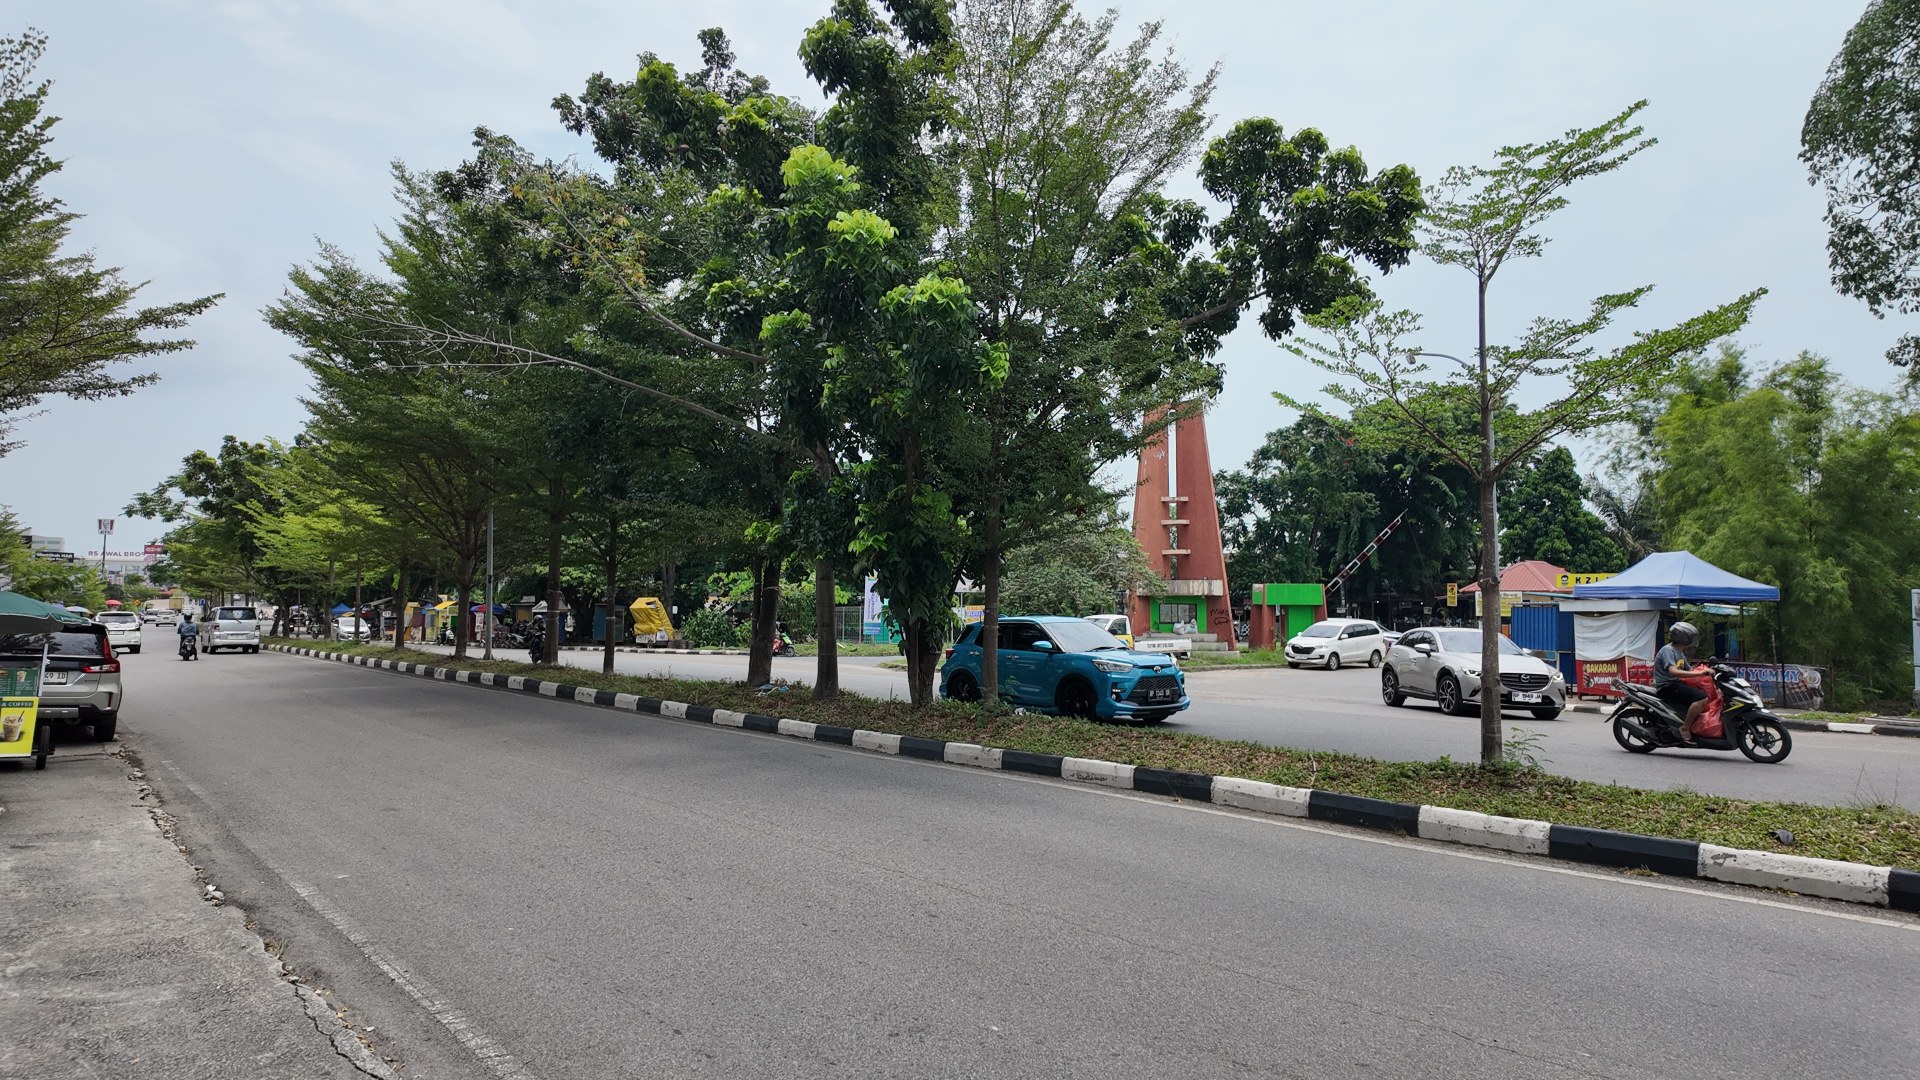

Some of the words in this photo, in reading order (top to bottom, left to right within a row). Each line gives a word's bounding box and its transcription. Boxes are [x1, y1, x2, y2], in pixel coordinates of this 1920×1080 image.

[1586, 663, 1617, 674] BAKARAN
[1593, 676, 1613, 685] YUMMY
[1747, 668, 1800, 683] YUMMY
